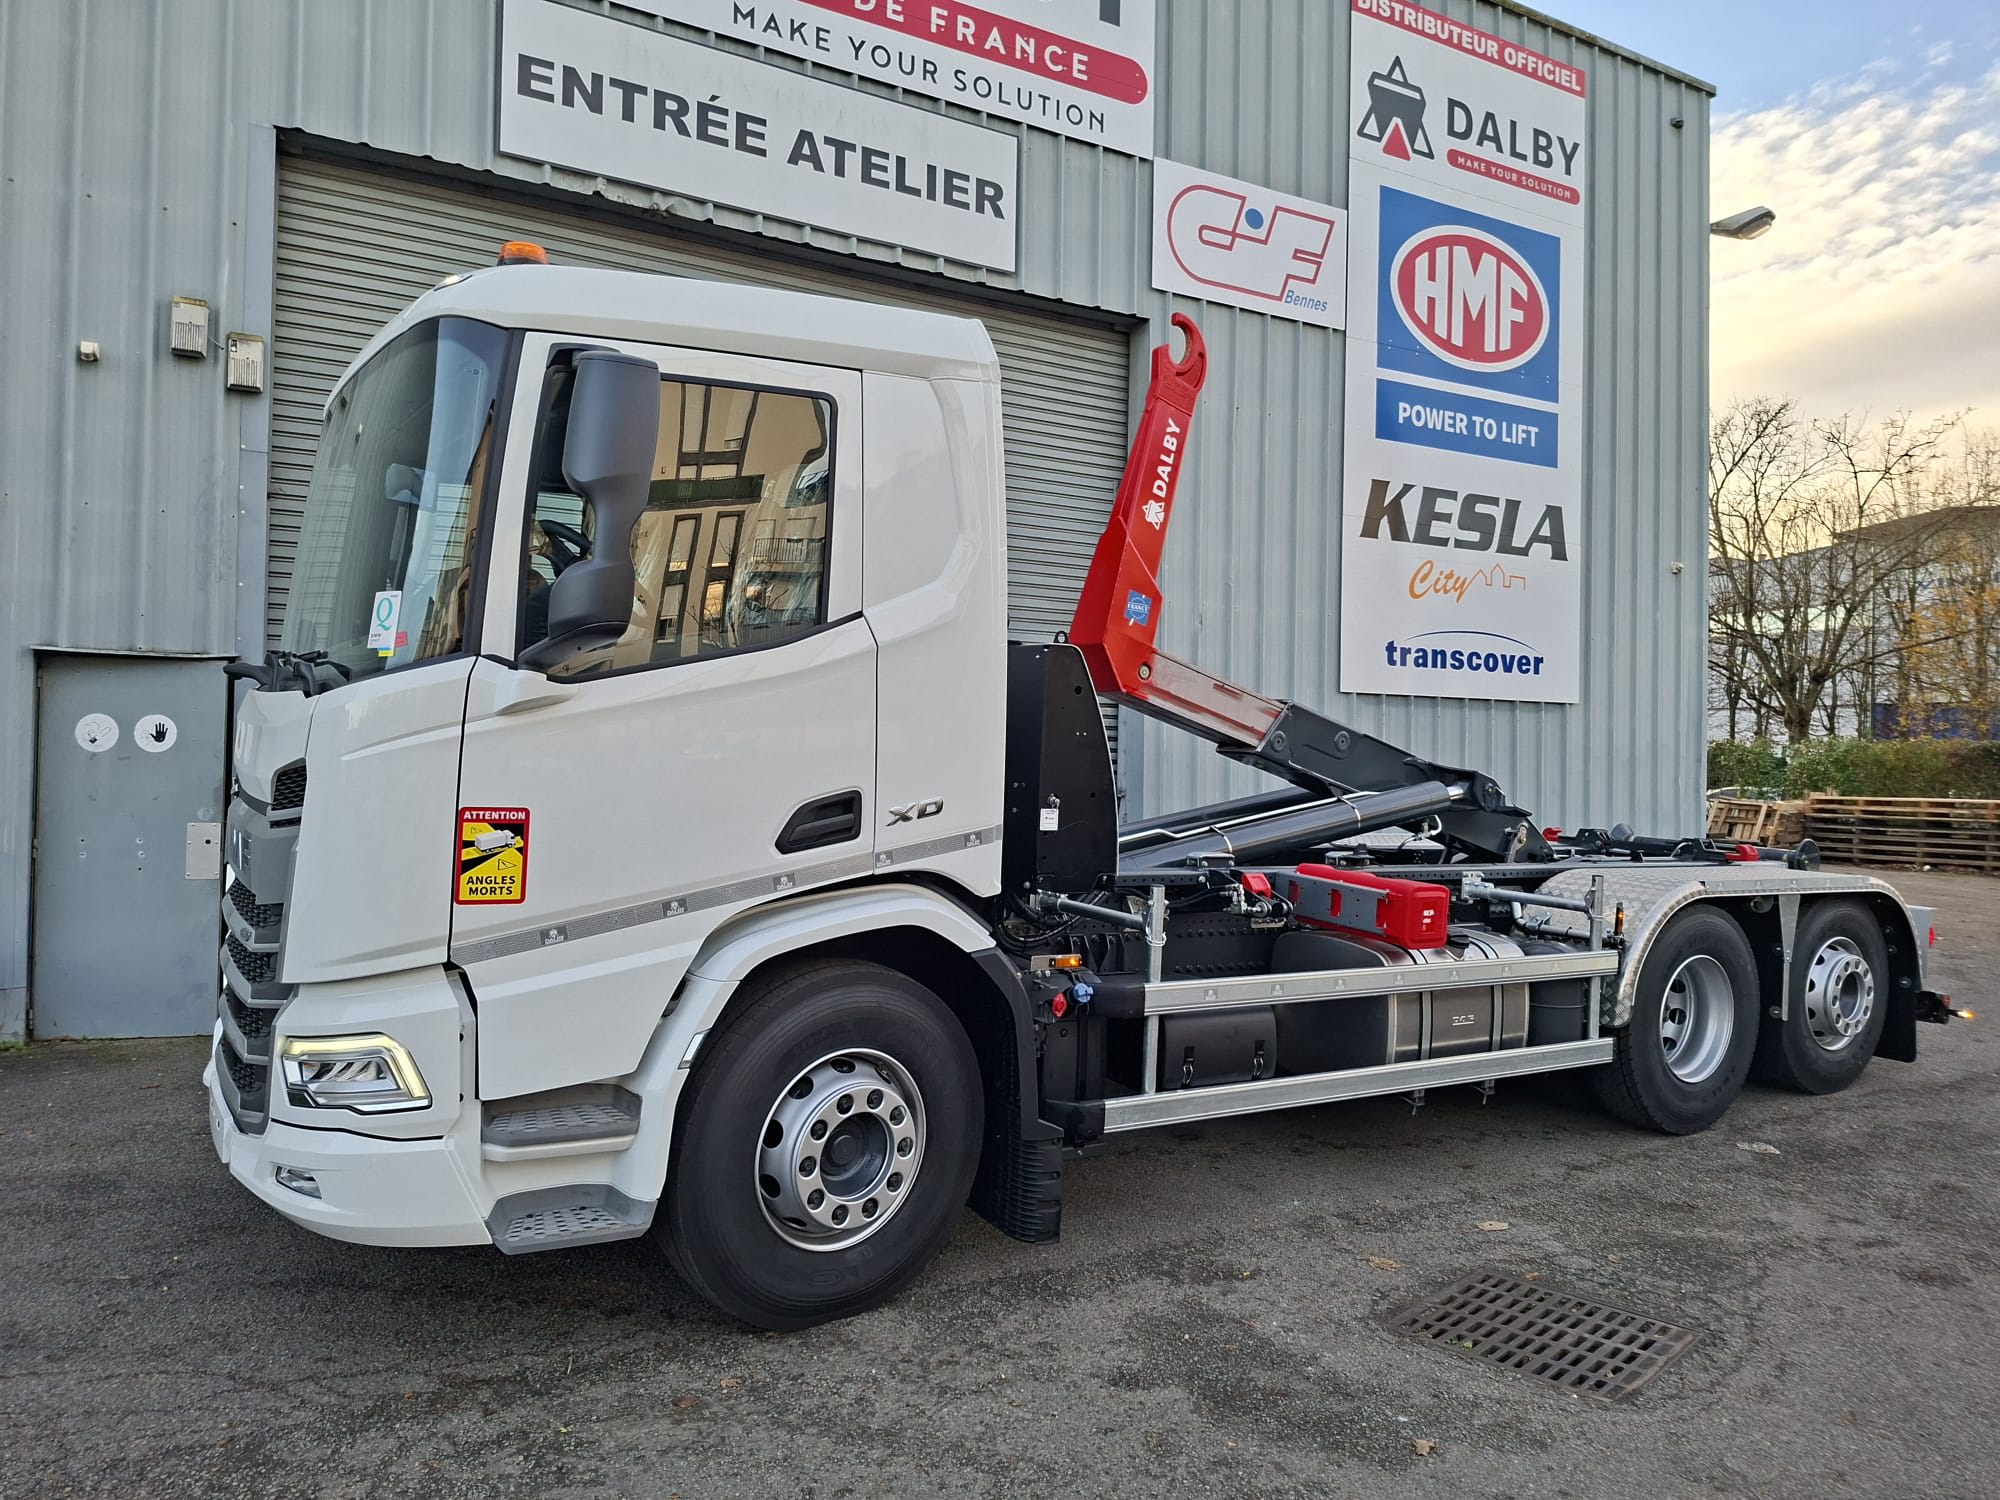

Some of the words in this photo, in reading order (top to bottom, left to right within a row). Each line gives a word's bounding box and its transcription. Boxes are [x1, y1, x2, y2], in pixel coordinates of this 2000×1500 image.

[930, 6, 1089, 82] FRANCE
[733, 0, 831, 52] MAKE
[847, 35, 938, 84] YOUR
[954, 69, 1104, 133] SOLUTION
[1503, 47, 1581, 92] OFFICIEL
[516, 53, 769, 158] ENTRÉE
[786, 129, 1005, 220] ATELIER
[1447, 97, 1580, 176] DALBY
[1457, 155, 1486, 172] MAKE
[1491, 166, 1517, 182] YOUR
[1521, 176, 1571, 199] SOLUTION
[1284, 289, 1328, 312] Bennes
[1414, 245, 1528, 353] HMF
[1398, 402, 1467, 435] POWER
[1472, 416, 1497, 440] TO
[1502, 422, 1539, 447] LIFT
[1152, 418, 1182, 498] DALBY
[1359, 478, 1568, 562] KESLA
[1408, 559, 1470, 603] City
[376, 597, 394, 631] Q
[1385, 640, 1544, 676] transcover
[463, 810, 526, 820] ATTENTION
[886, 796, 944, 827] XD
[466, 875, 516, 885] ANGLES
[468, 886, 513, 896] MORTS
